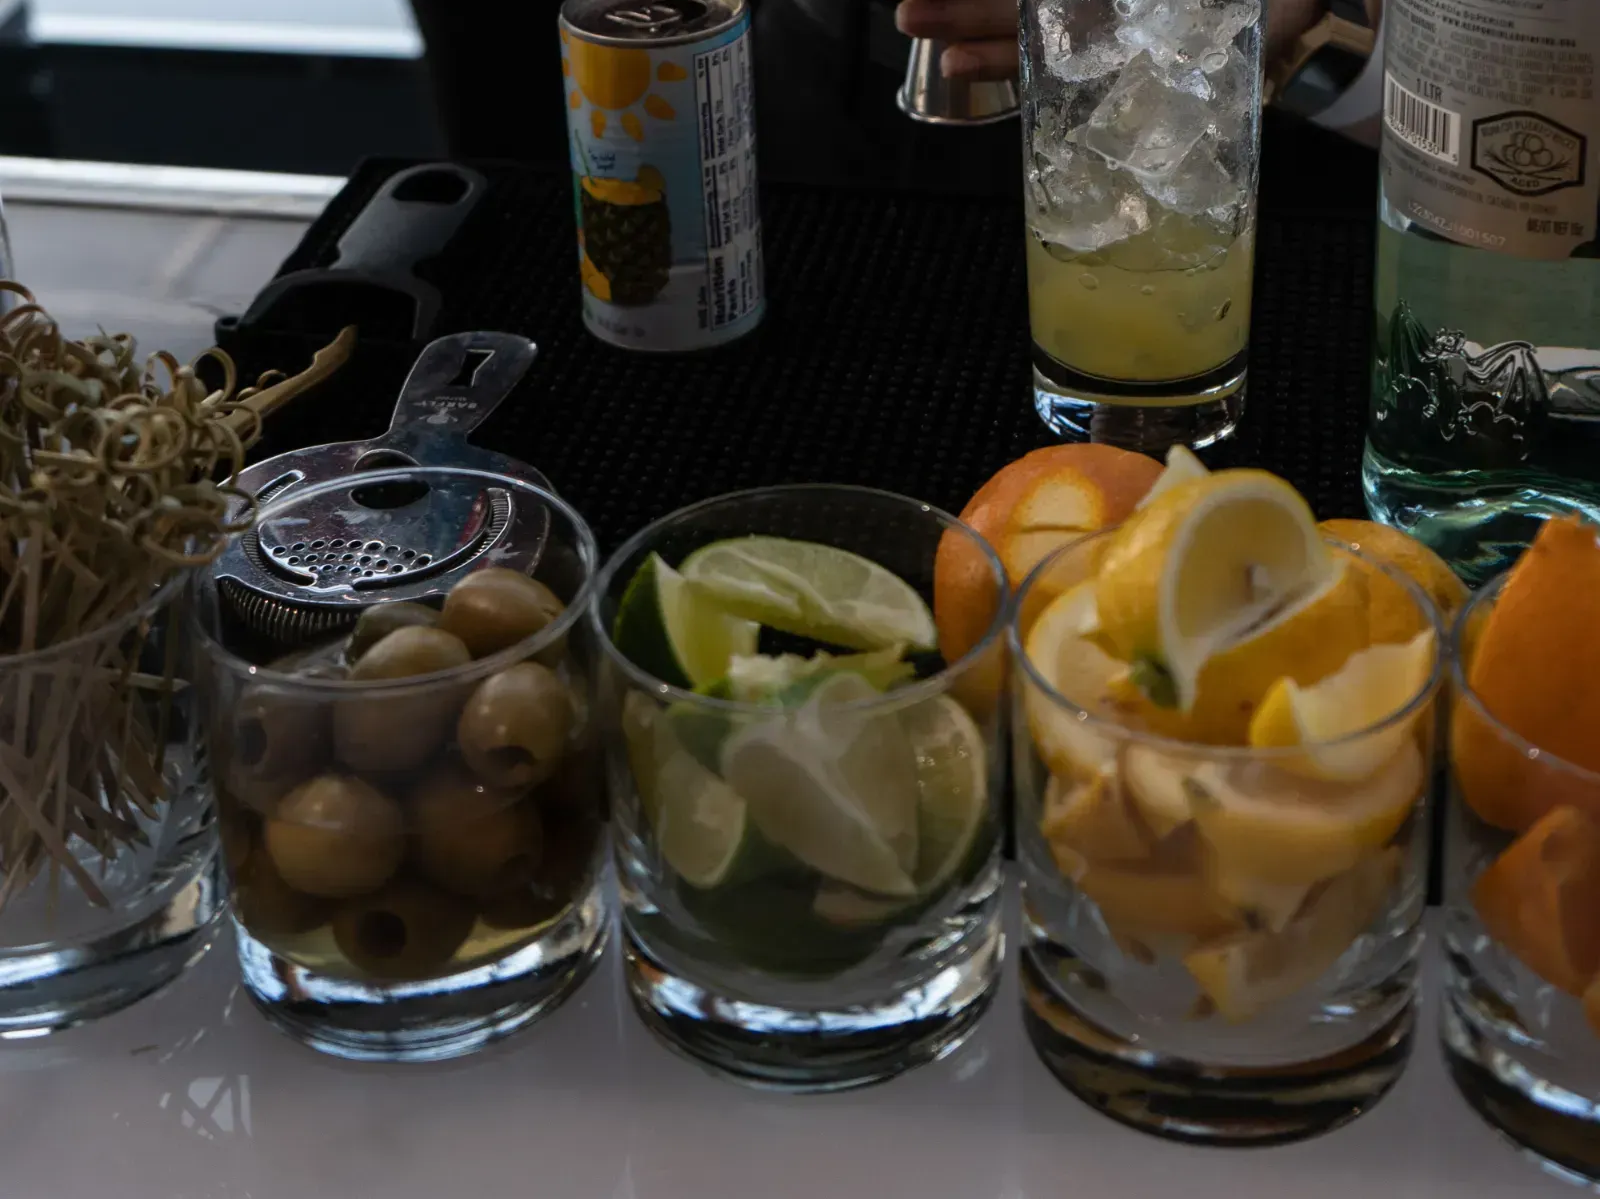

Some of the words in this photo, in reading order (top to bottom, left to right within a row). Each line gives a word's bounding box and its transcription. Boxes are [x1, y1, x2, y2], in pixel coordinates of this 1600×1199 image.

[1424, 80, 1443, 103] LTR
[1410, 131, 1440, 156] 01530
[1510, 176, 1540, 189] AGED
[712, 256, 726, 326] Nutrition
[727, 279, 738, 322] Facts
